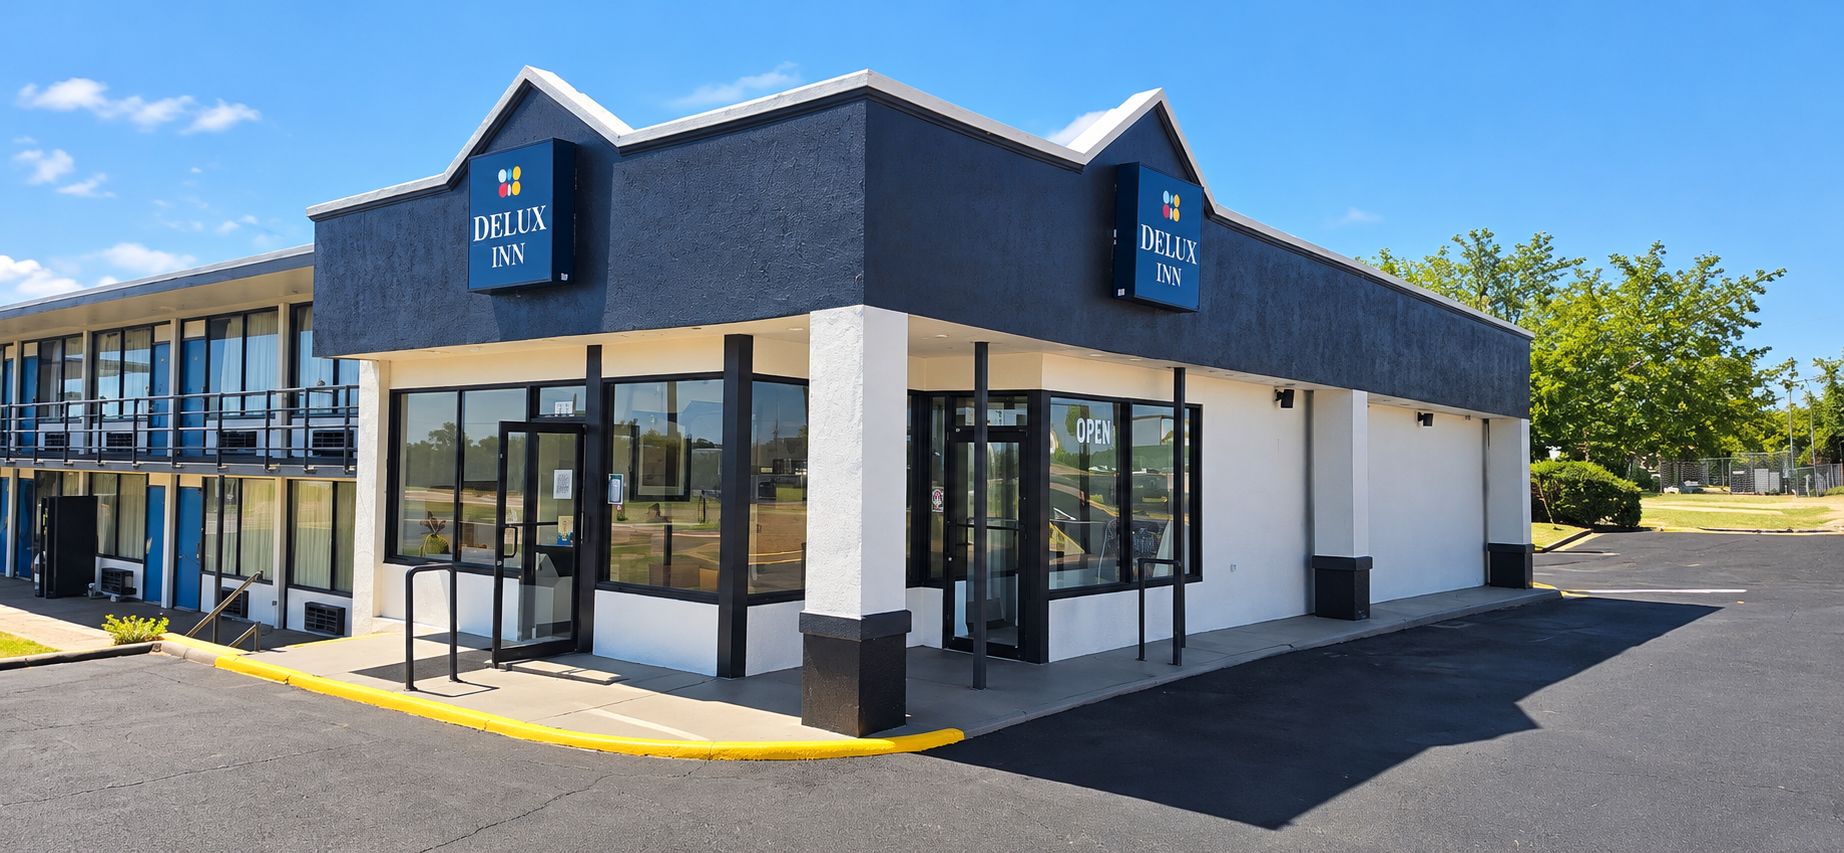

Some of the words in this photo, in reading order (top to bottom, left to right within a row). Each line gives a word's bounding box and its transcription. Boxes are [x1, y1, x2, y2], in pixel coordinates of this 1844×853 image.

[473, 205, 546, 242] DELUX
[492, 243, 525, 268] INN
[1140, 223, 1198, 265] DELUX
[1156, 263, 1181, 287] INN
[1076, 418, 1111, 445] OPEN
